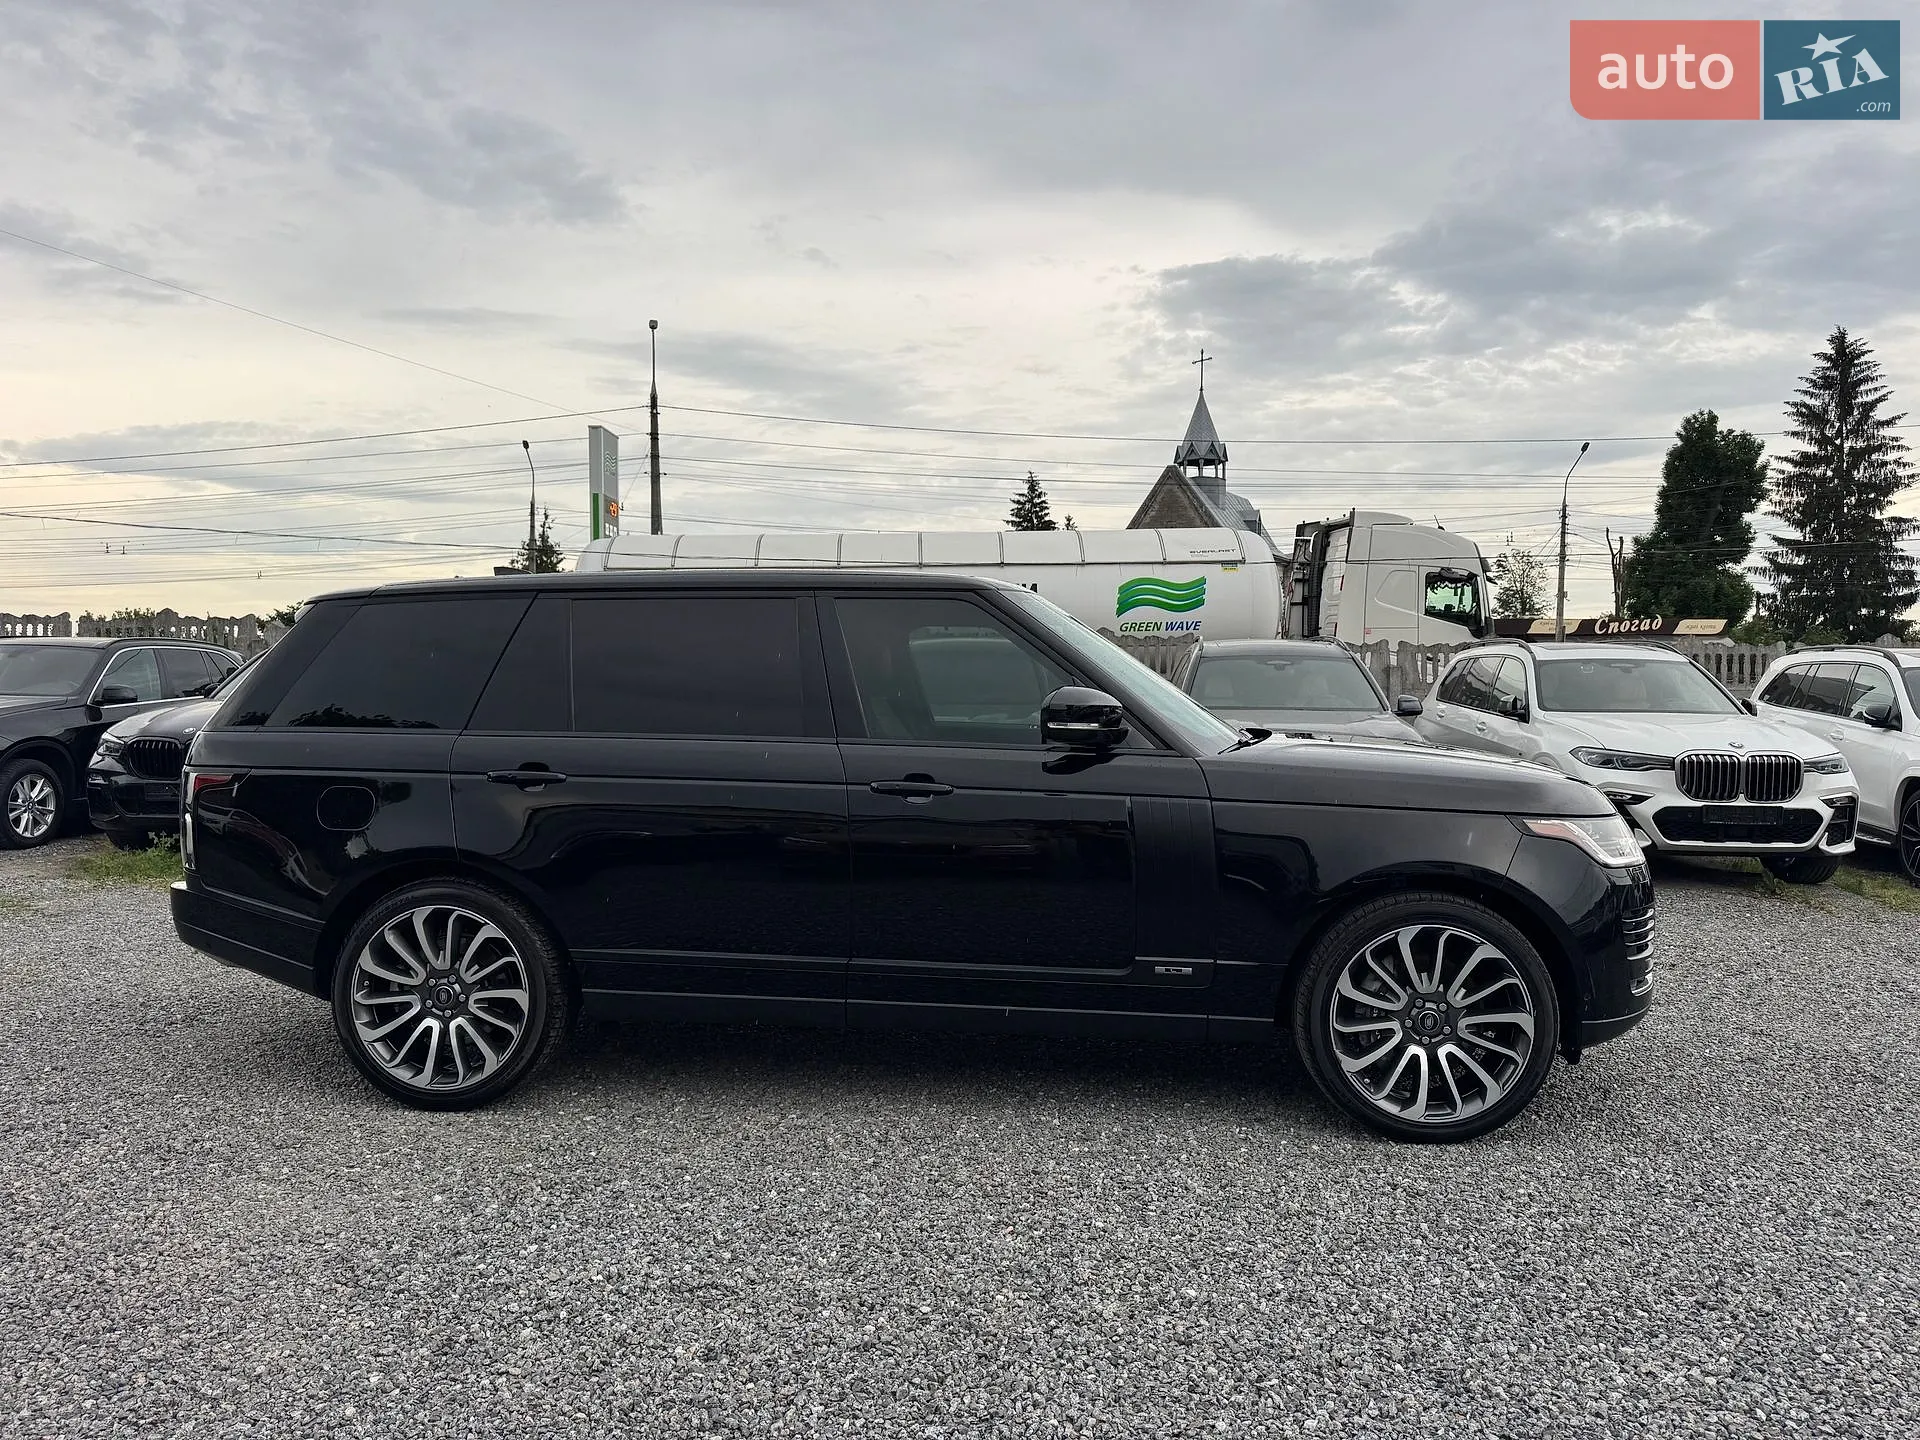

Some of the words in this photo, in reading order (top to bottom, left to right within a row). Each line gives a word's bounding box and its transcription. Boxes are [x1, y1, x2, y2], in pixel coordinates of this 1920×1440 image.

[1120, 621, 1162, 632] GREEN
[1165, 620, 1202, 631] WAVE
[1594, 614, 1663, 634] Спогад
